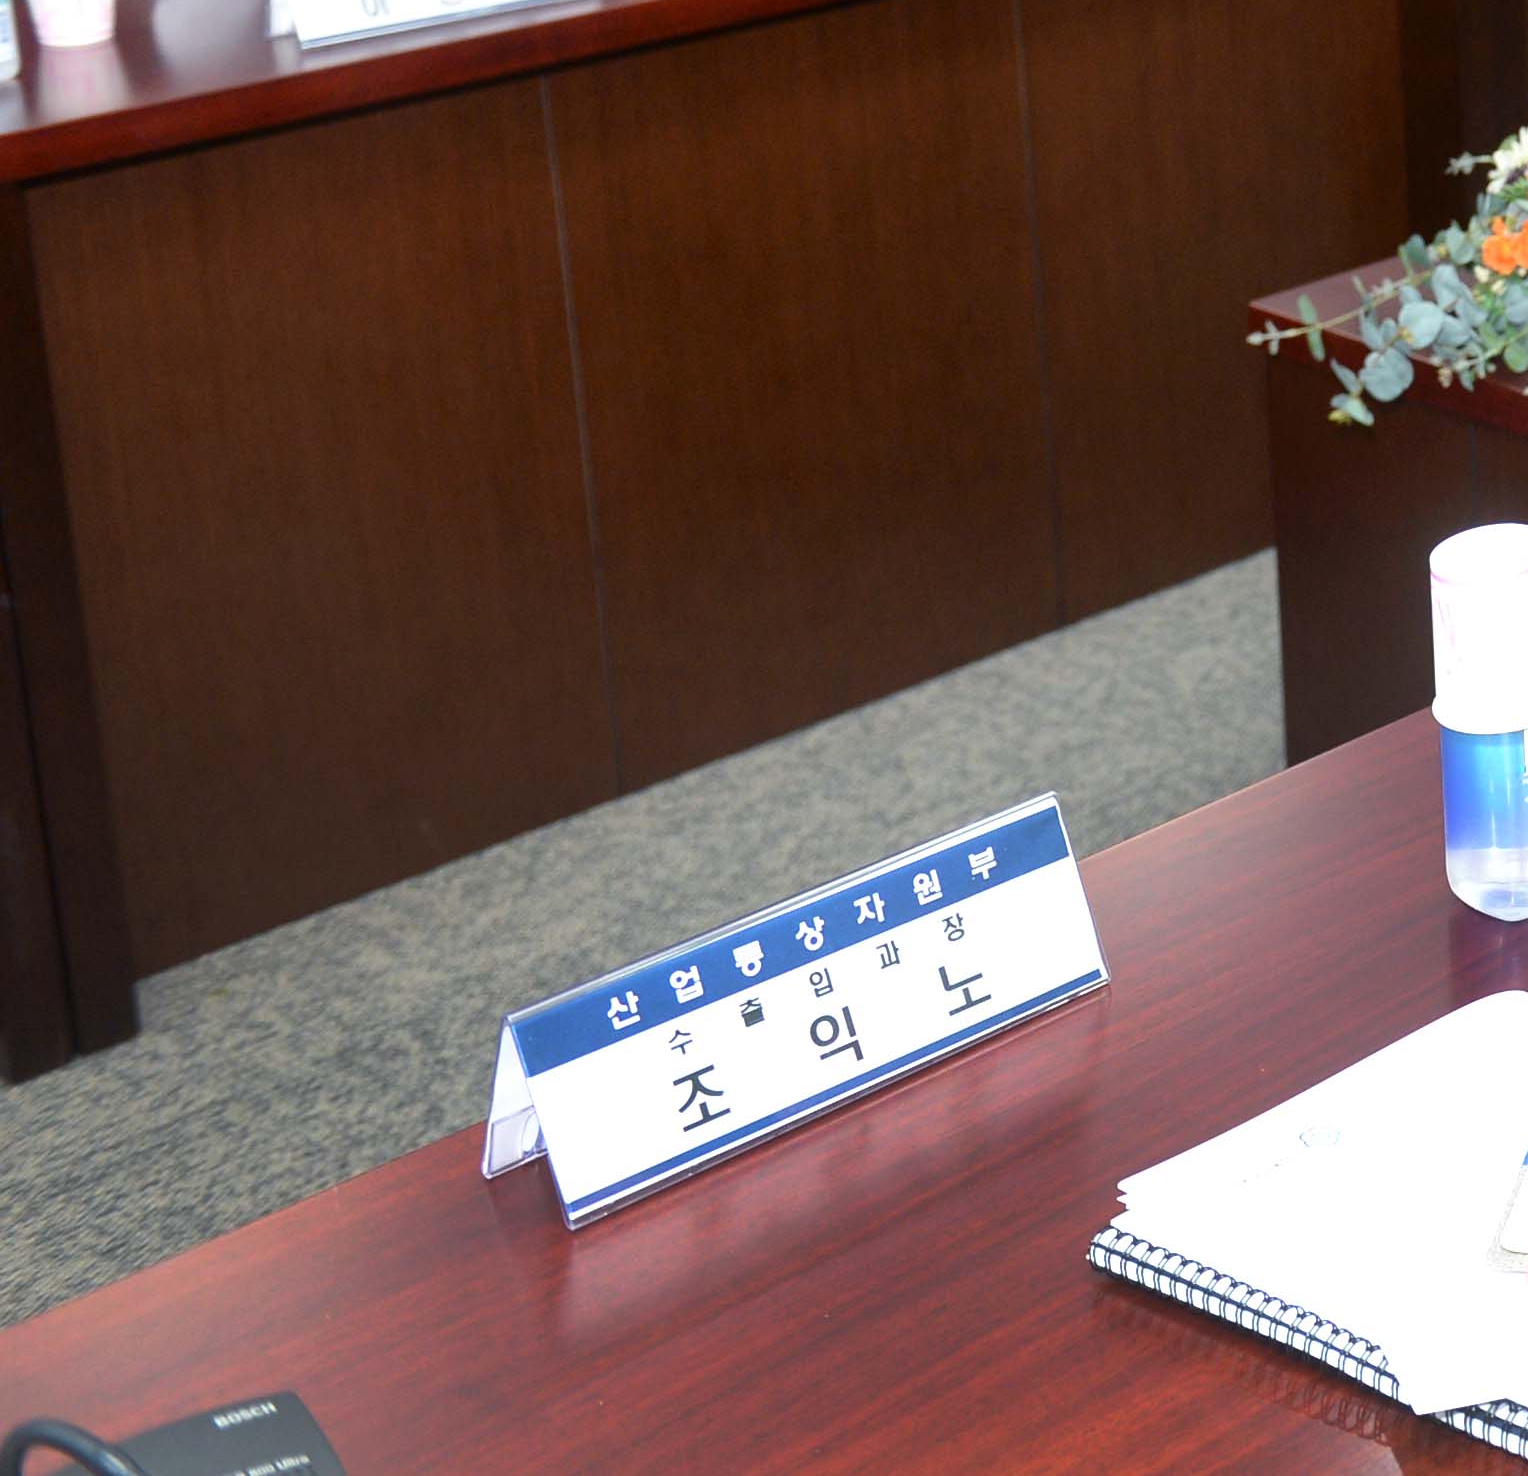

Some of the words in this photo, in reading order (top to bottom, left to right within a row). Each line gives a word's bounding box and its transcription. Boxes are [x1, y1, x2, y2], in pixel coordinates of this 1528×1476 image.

[607, 846, 998, 1031] 산업통상자원부
[668, 914, 966, 1056] 수출입과장
[672, 966, 992, 1133] 조익노
[213, 1401, 277, 1429] BOSCH
